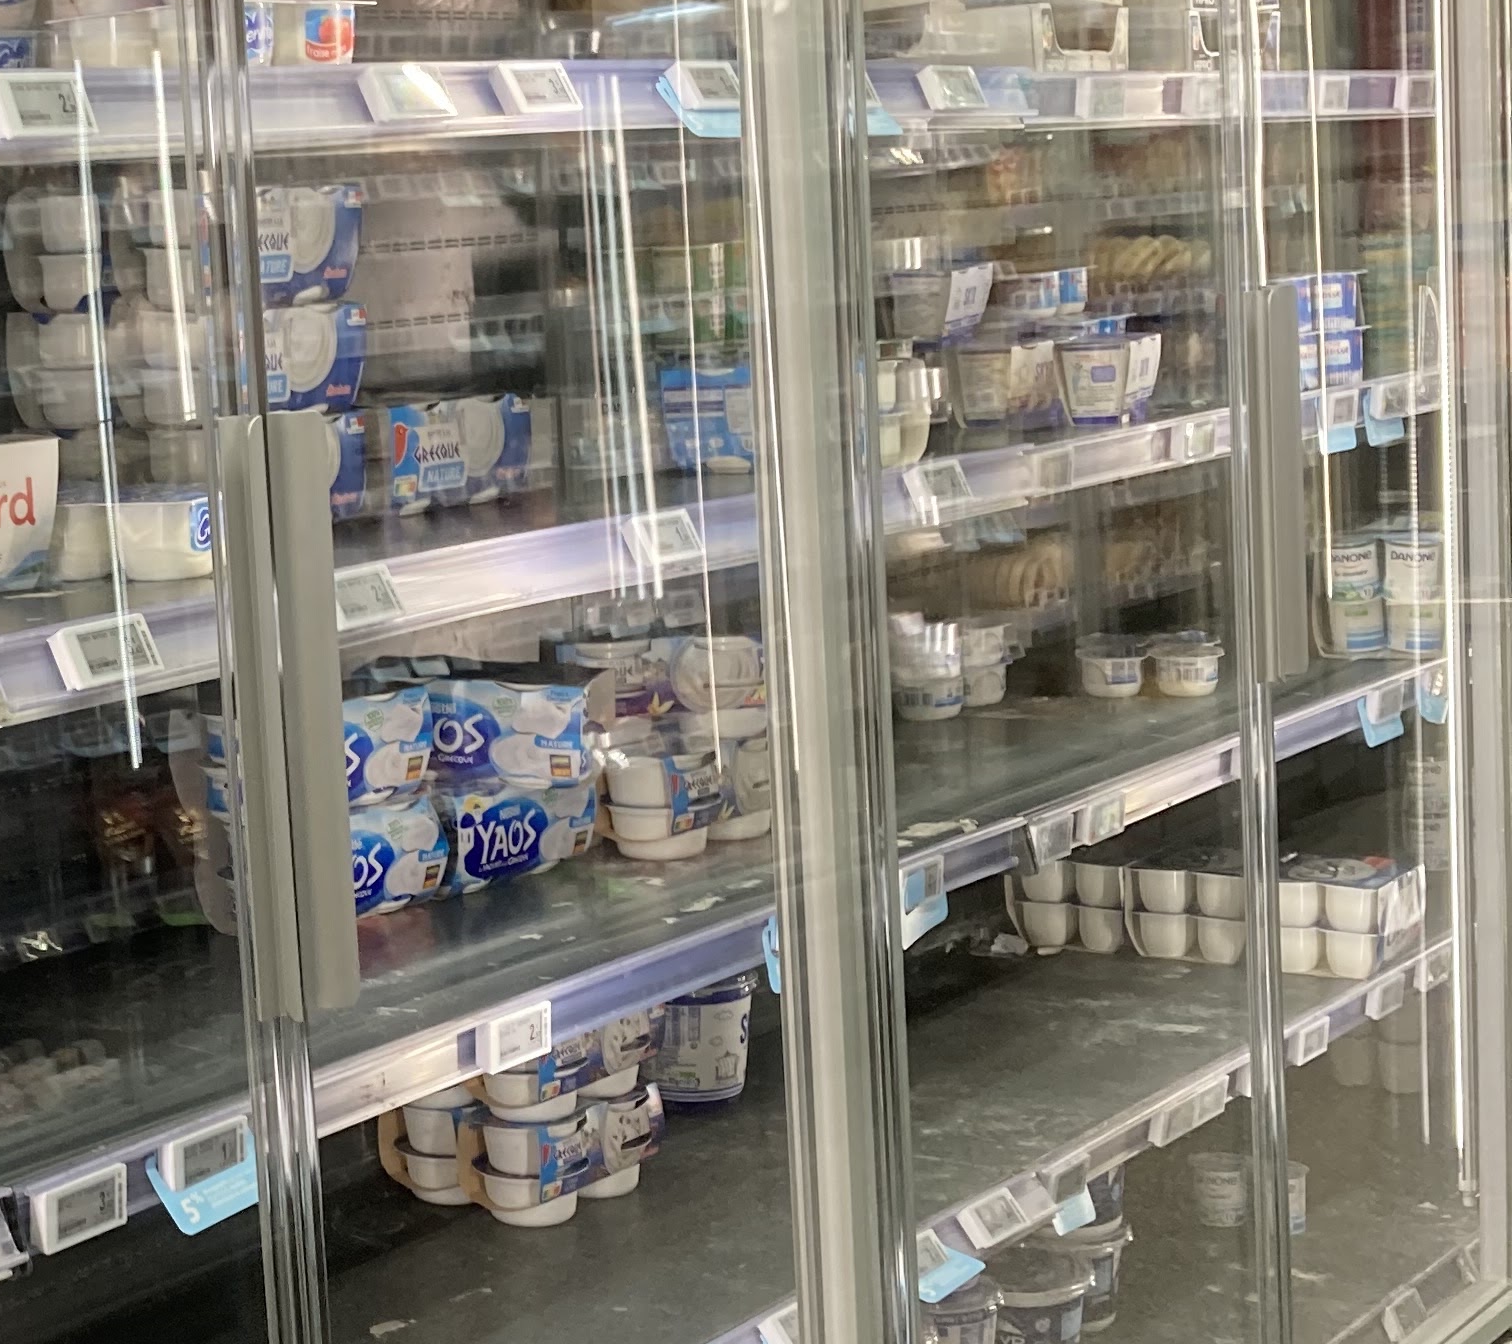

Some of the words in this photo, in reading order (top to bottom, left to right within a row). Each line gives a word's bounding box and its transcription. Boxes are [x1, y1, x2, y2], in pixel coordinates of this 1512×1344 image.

[414, 443, 460, 463] GRECQUE
[426, 465, 462, 482] NATURE
[476, 809, 536, 865] YAOS
